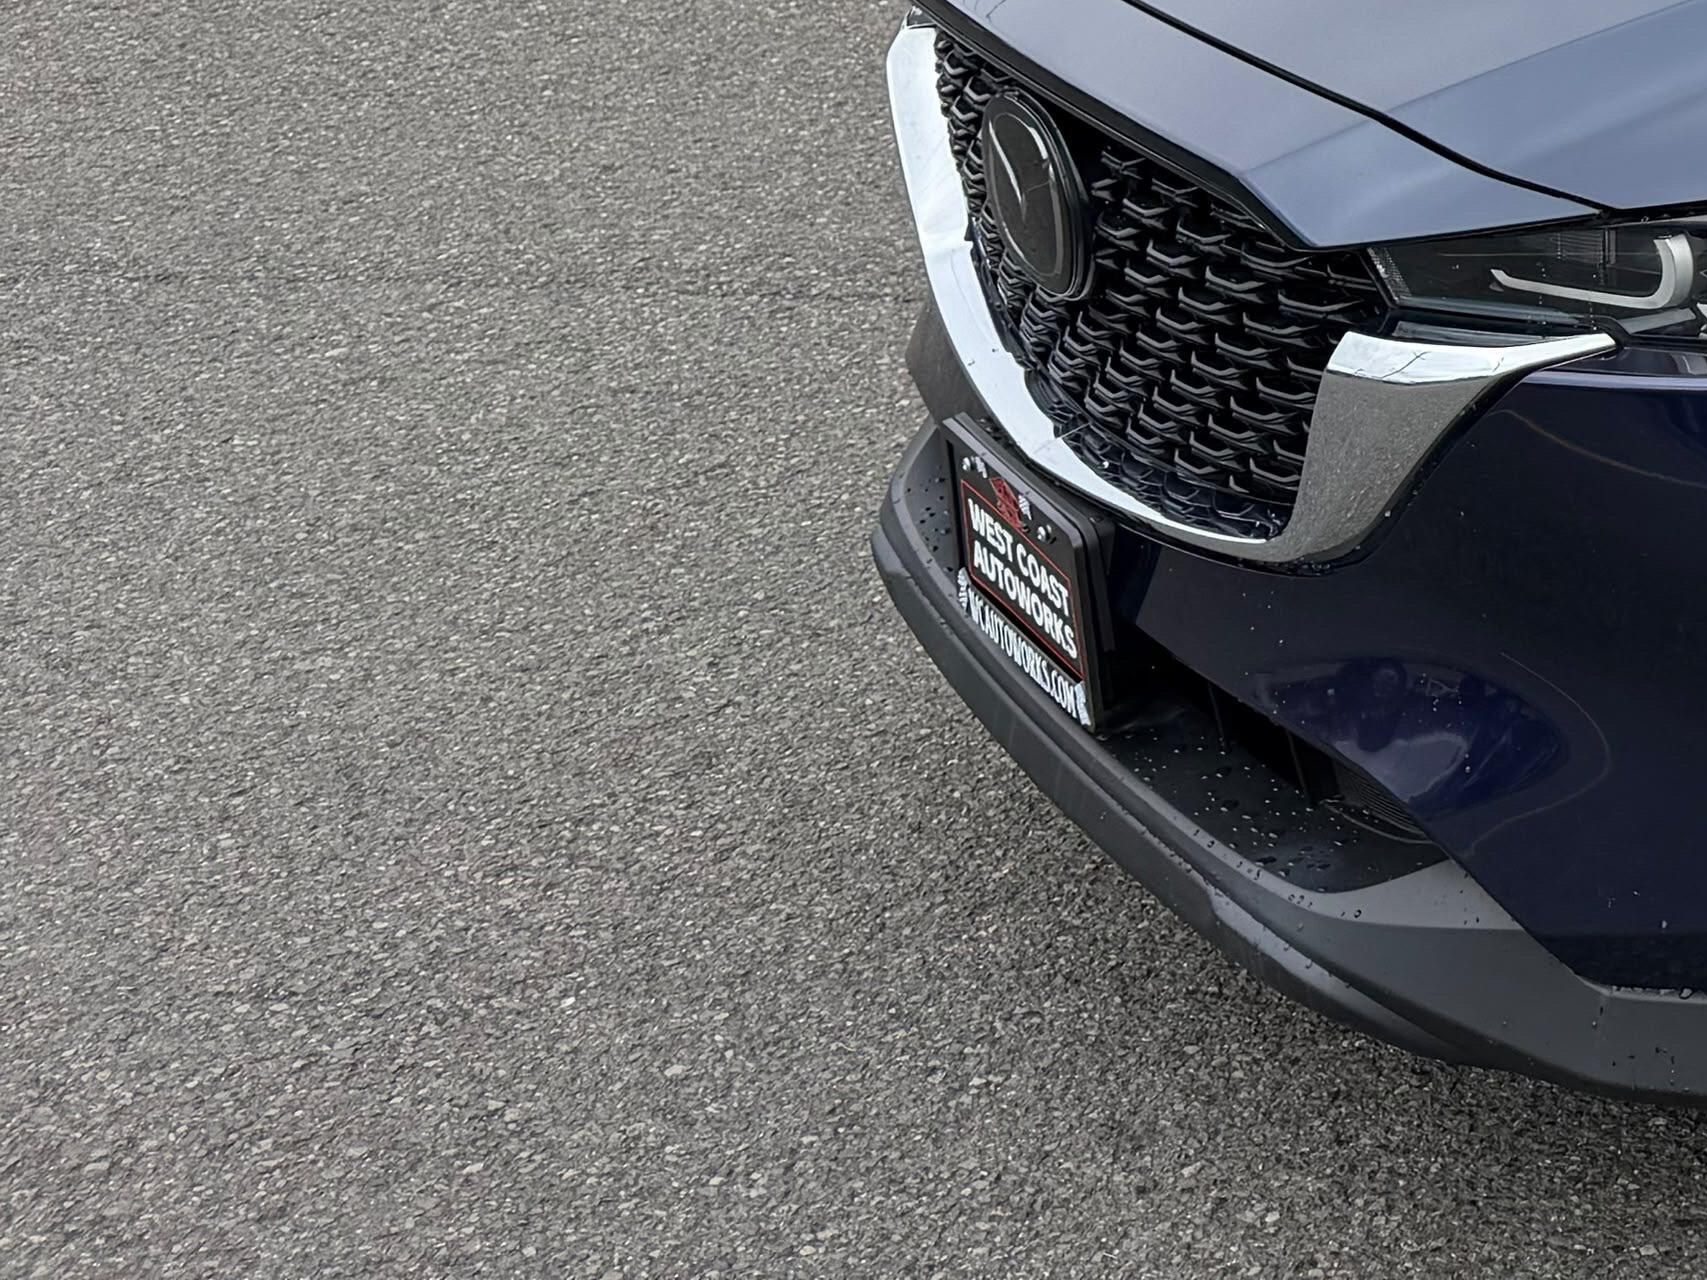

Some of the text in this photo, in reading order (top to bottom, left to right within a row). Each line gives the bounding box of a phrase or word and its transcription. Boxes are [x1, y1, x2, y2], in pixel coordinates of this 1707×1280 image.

[968, 497, 1069, 617] WEST COAST
[974, 541, 1077, 659] AUTOWORKS
[967, 588, 1078, 718] WCAUTOWORKS.COM
